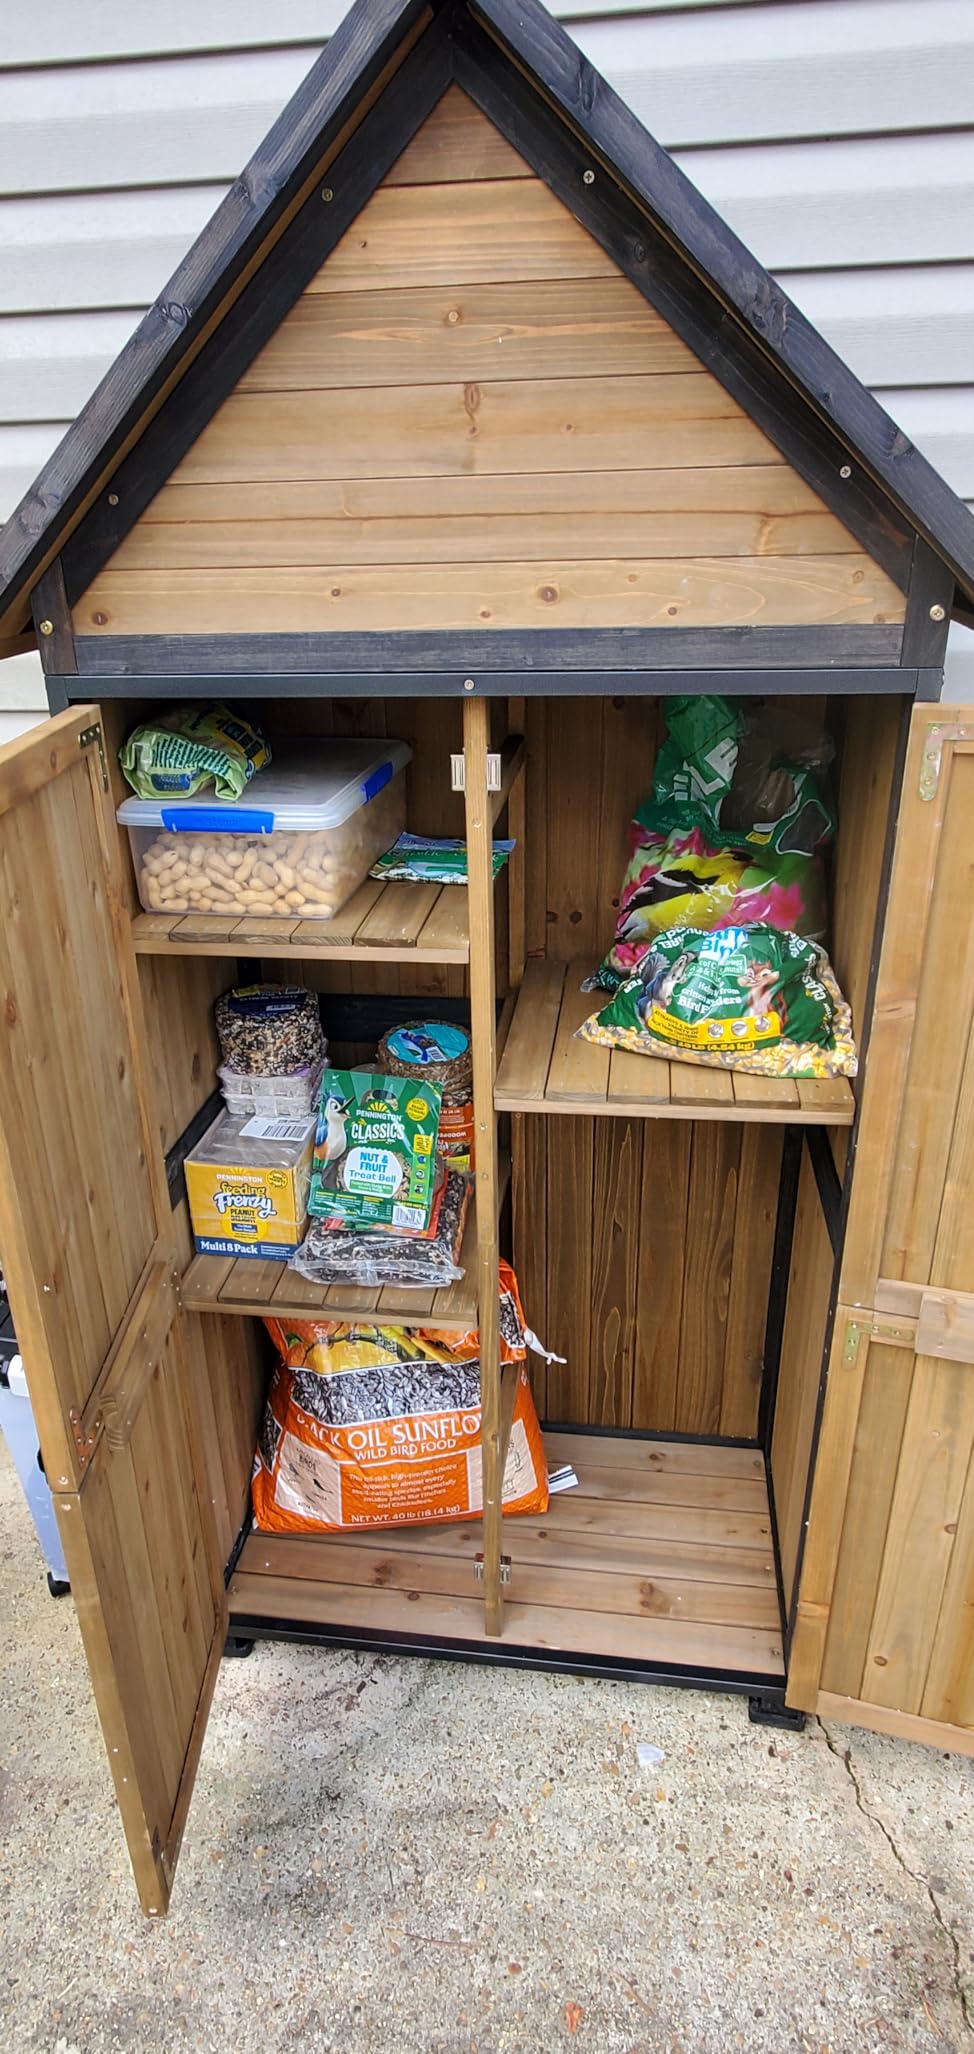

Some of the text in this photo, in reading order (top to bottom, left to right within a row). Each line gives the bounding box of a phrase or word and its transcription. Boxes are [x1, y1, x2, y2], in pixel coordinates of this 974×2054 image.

[356, 1110, 402, 1121] PENNINGTON
[351, 1122, 406, 1140] CLASSICS
[359, 1152, 388, 1163] NUT &
[359, 1161, 388, 1173] FRUIT
[216, 1173, 263, 1183] PENNINGTON
[349, 1169, 396, 1183] Treat Bell
[220, 1182, 266, 1199] feeding
[213, 1192, 277, 1219] Frenzy
[230, 1208, 256, 1217] PEANUT
[200, 1240, 226, 1251] Multi
[227, 1243, 234, 1252] 8
[234, 1243, 259, 1254] Pack
[347, 1428, 388, 1450] OIL
[392, 1413, 482, 1445] SUNFLO
[354, 1439, 457, 1461] WILD BIRD FOOD
[351, 1514, 369, 1523] NET
[370, 1513, 391, 1522] WT.
[406, 1511, 416, 1519] lb
[417, 1507, 445, 1519] (18.14
[445, 1504, 460, 1515] kg)
